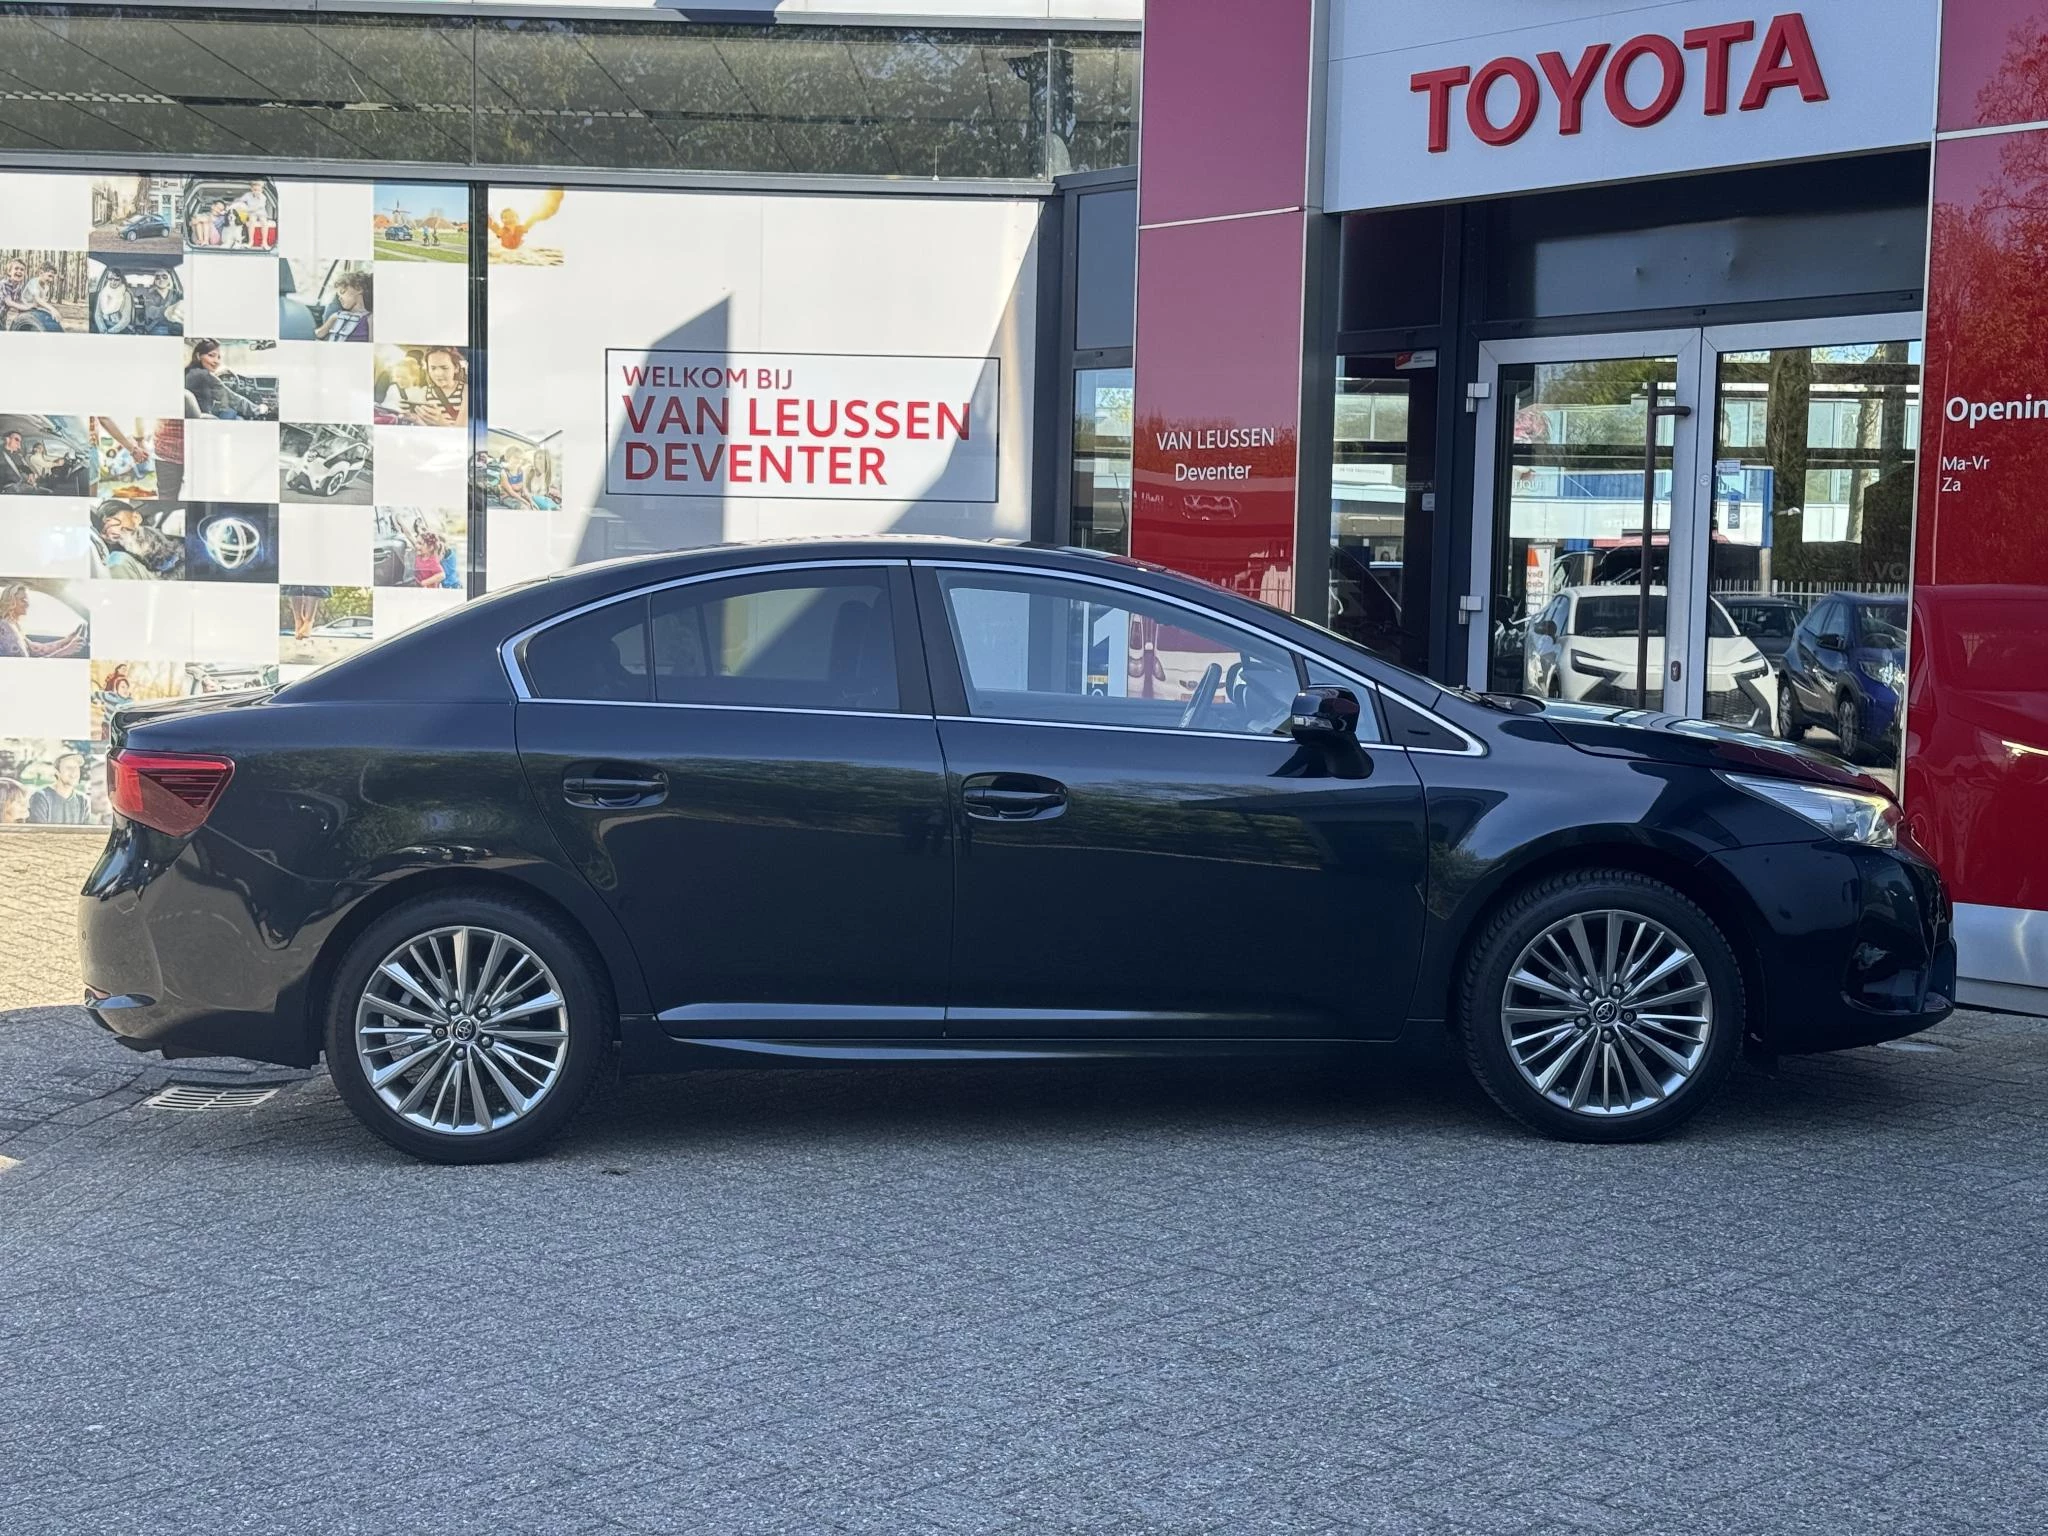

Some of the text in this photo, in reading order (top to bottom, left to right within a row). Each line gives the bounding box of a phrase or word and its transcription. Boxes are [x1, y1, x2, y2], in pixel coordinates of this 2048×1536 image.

[1410, 13, 1829, 153] TOYOTA
[622, 365, 793, 390] WELKOM BIJ
[622, 395, 971, 441] VAN LEUSSEN
[1156, 427, 1275, 450] VAN LEUSSEN
[625, 442, 888, 485] DEVENTER
[1175, 463, 1252, 482] Deventer
[1942, 455, 1990, 471] Ma-Vr
[1941, 477, 1961, 492] Za
